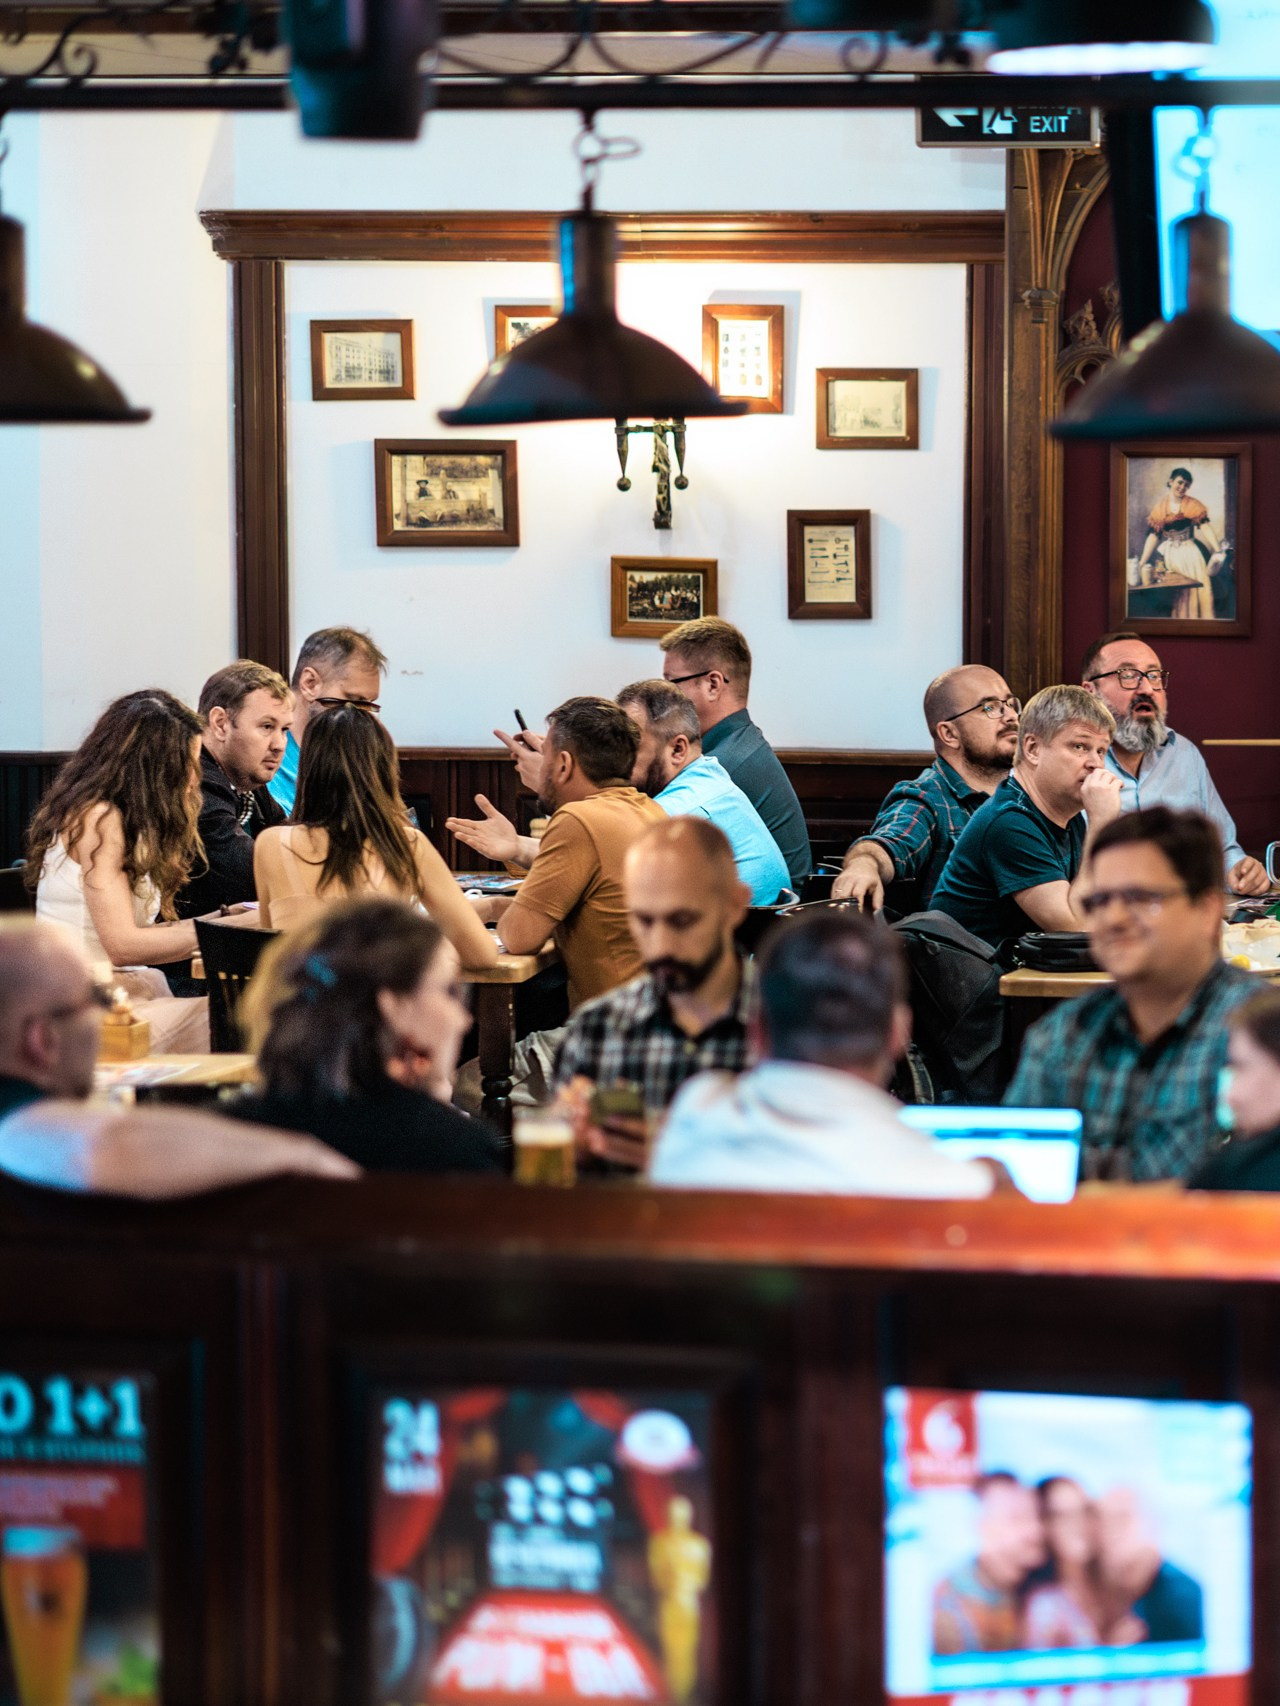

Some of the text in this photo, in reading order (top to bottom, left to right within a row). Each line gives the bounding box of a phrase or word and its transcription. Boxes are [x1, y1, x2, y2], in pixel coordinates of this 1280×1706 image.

[1029, 115, 1069, 133] EXIT
[45, 1375, 145, 1438] 1+1
[383, 1398, 440, 1460] 24
